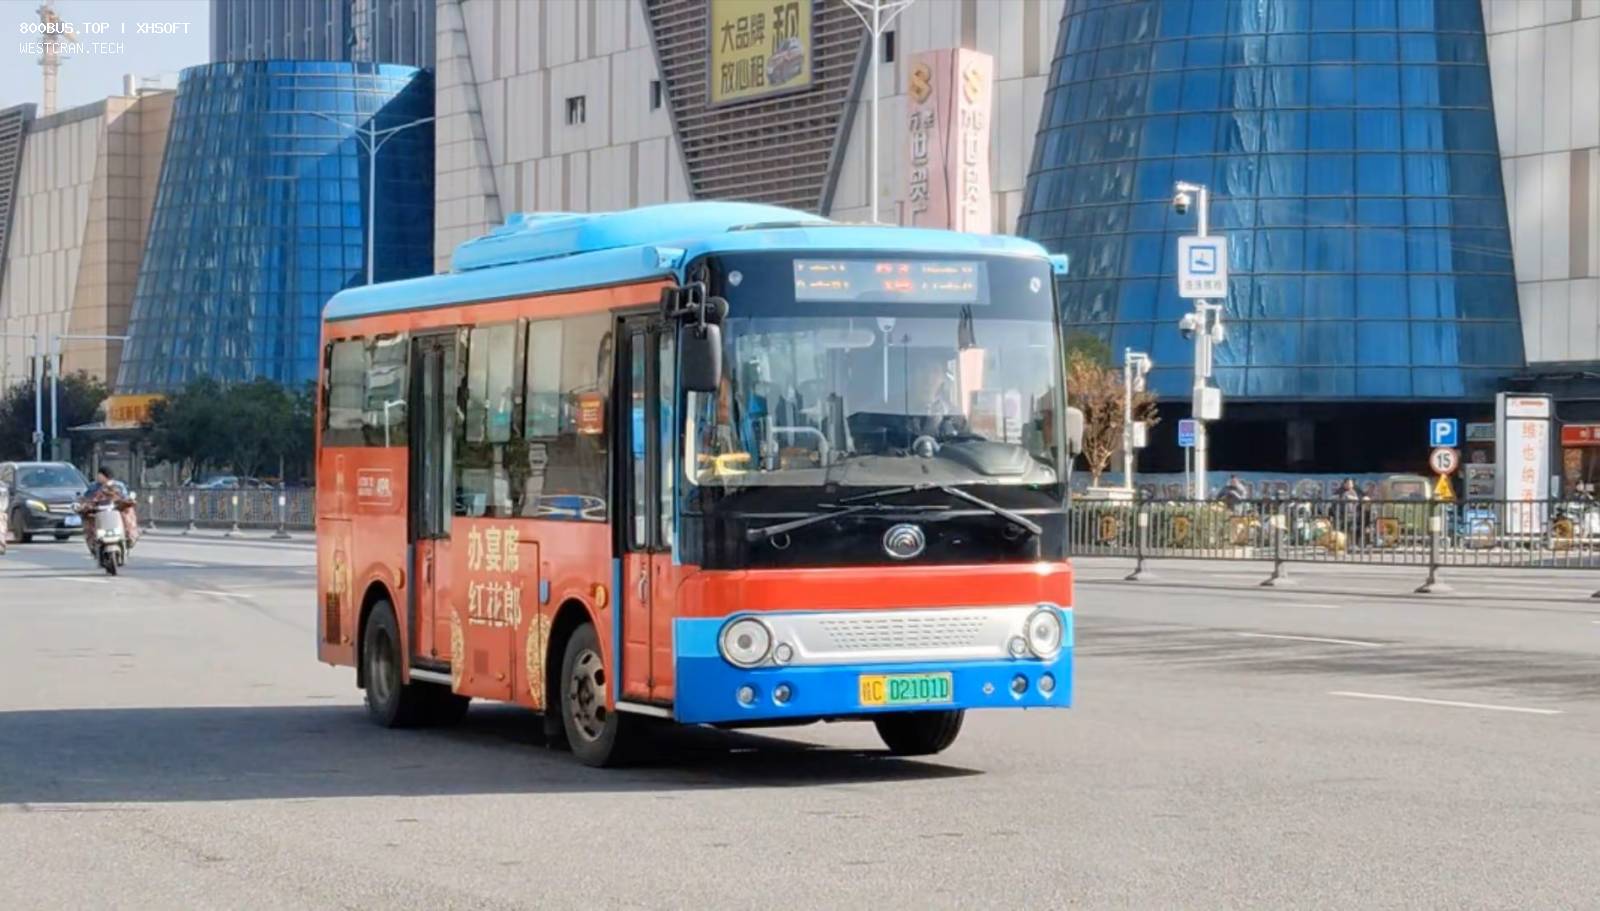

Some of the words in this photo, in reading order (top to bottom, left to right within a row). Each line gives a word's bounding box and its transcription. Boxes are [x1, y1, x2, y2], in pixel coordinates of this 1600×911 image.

[721, 13, 765, 53] 大品牌
[721, 55, 765, 95] 放心租
[1435, 422, 1451, 443] P
[1437, 452, 1451, 469] 15
[467, 524, 520, 572] 办宴席
[467, 579, 522, 630] 红花郎
